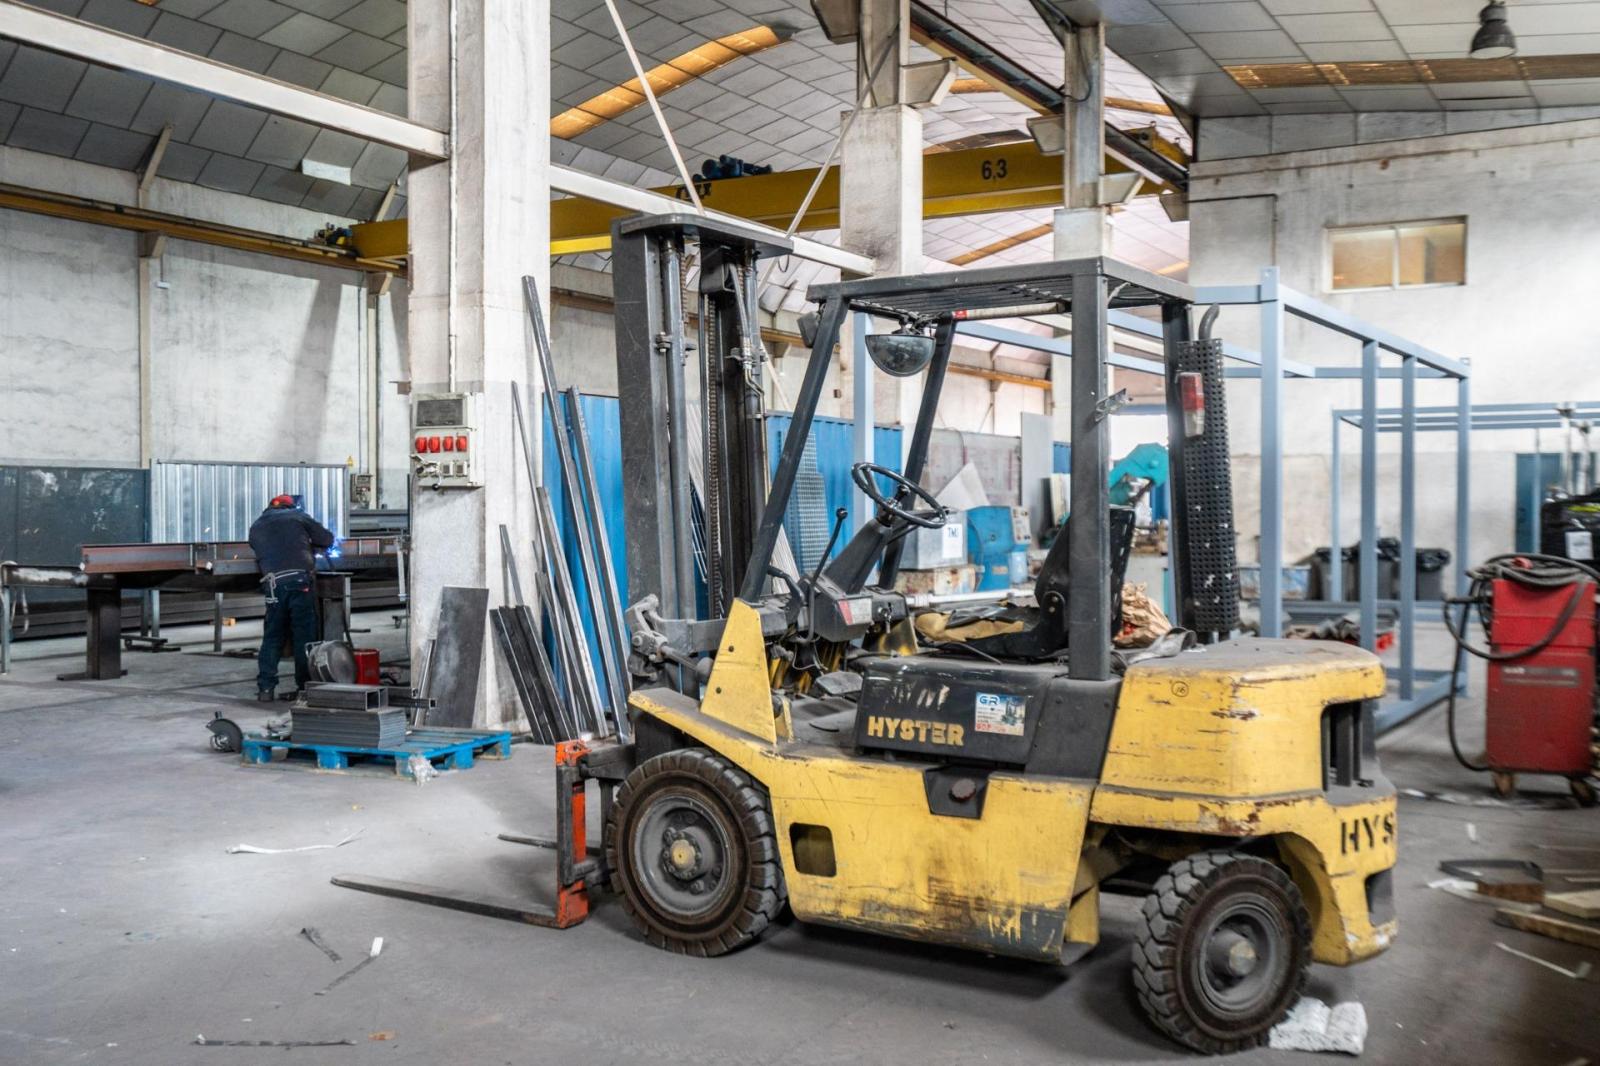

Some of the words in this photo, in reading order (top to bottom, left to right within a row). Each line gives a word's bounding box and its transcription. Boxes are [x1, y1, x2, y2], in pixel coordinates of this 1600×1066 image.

[980, 695, 998, 704] GR
[867, 715, 965, 746] HYSTER
[1341, 812, 1394, 855] HYS
